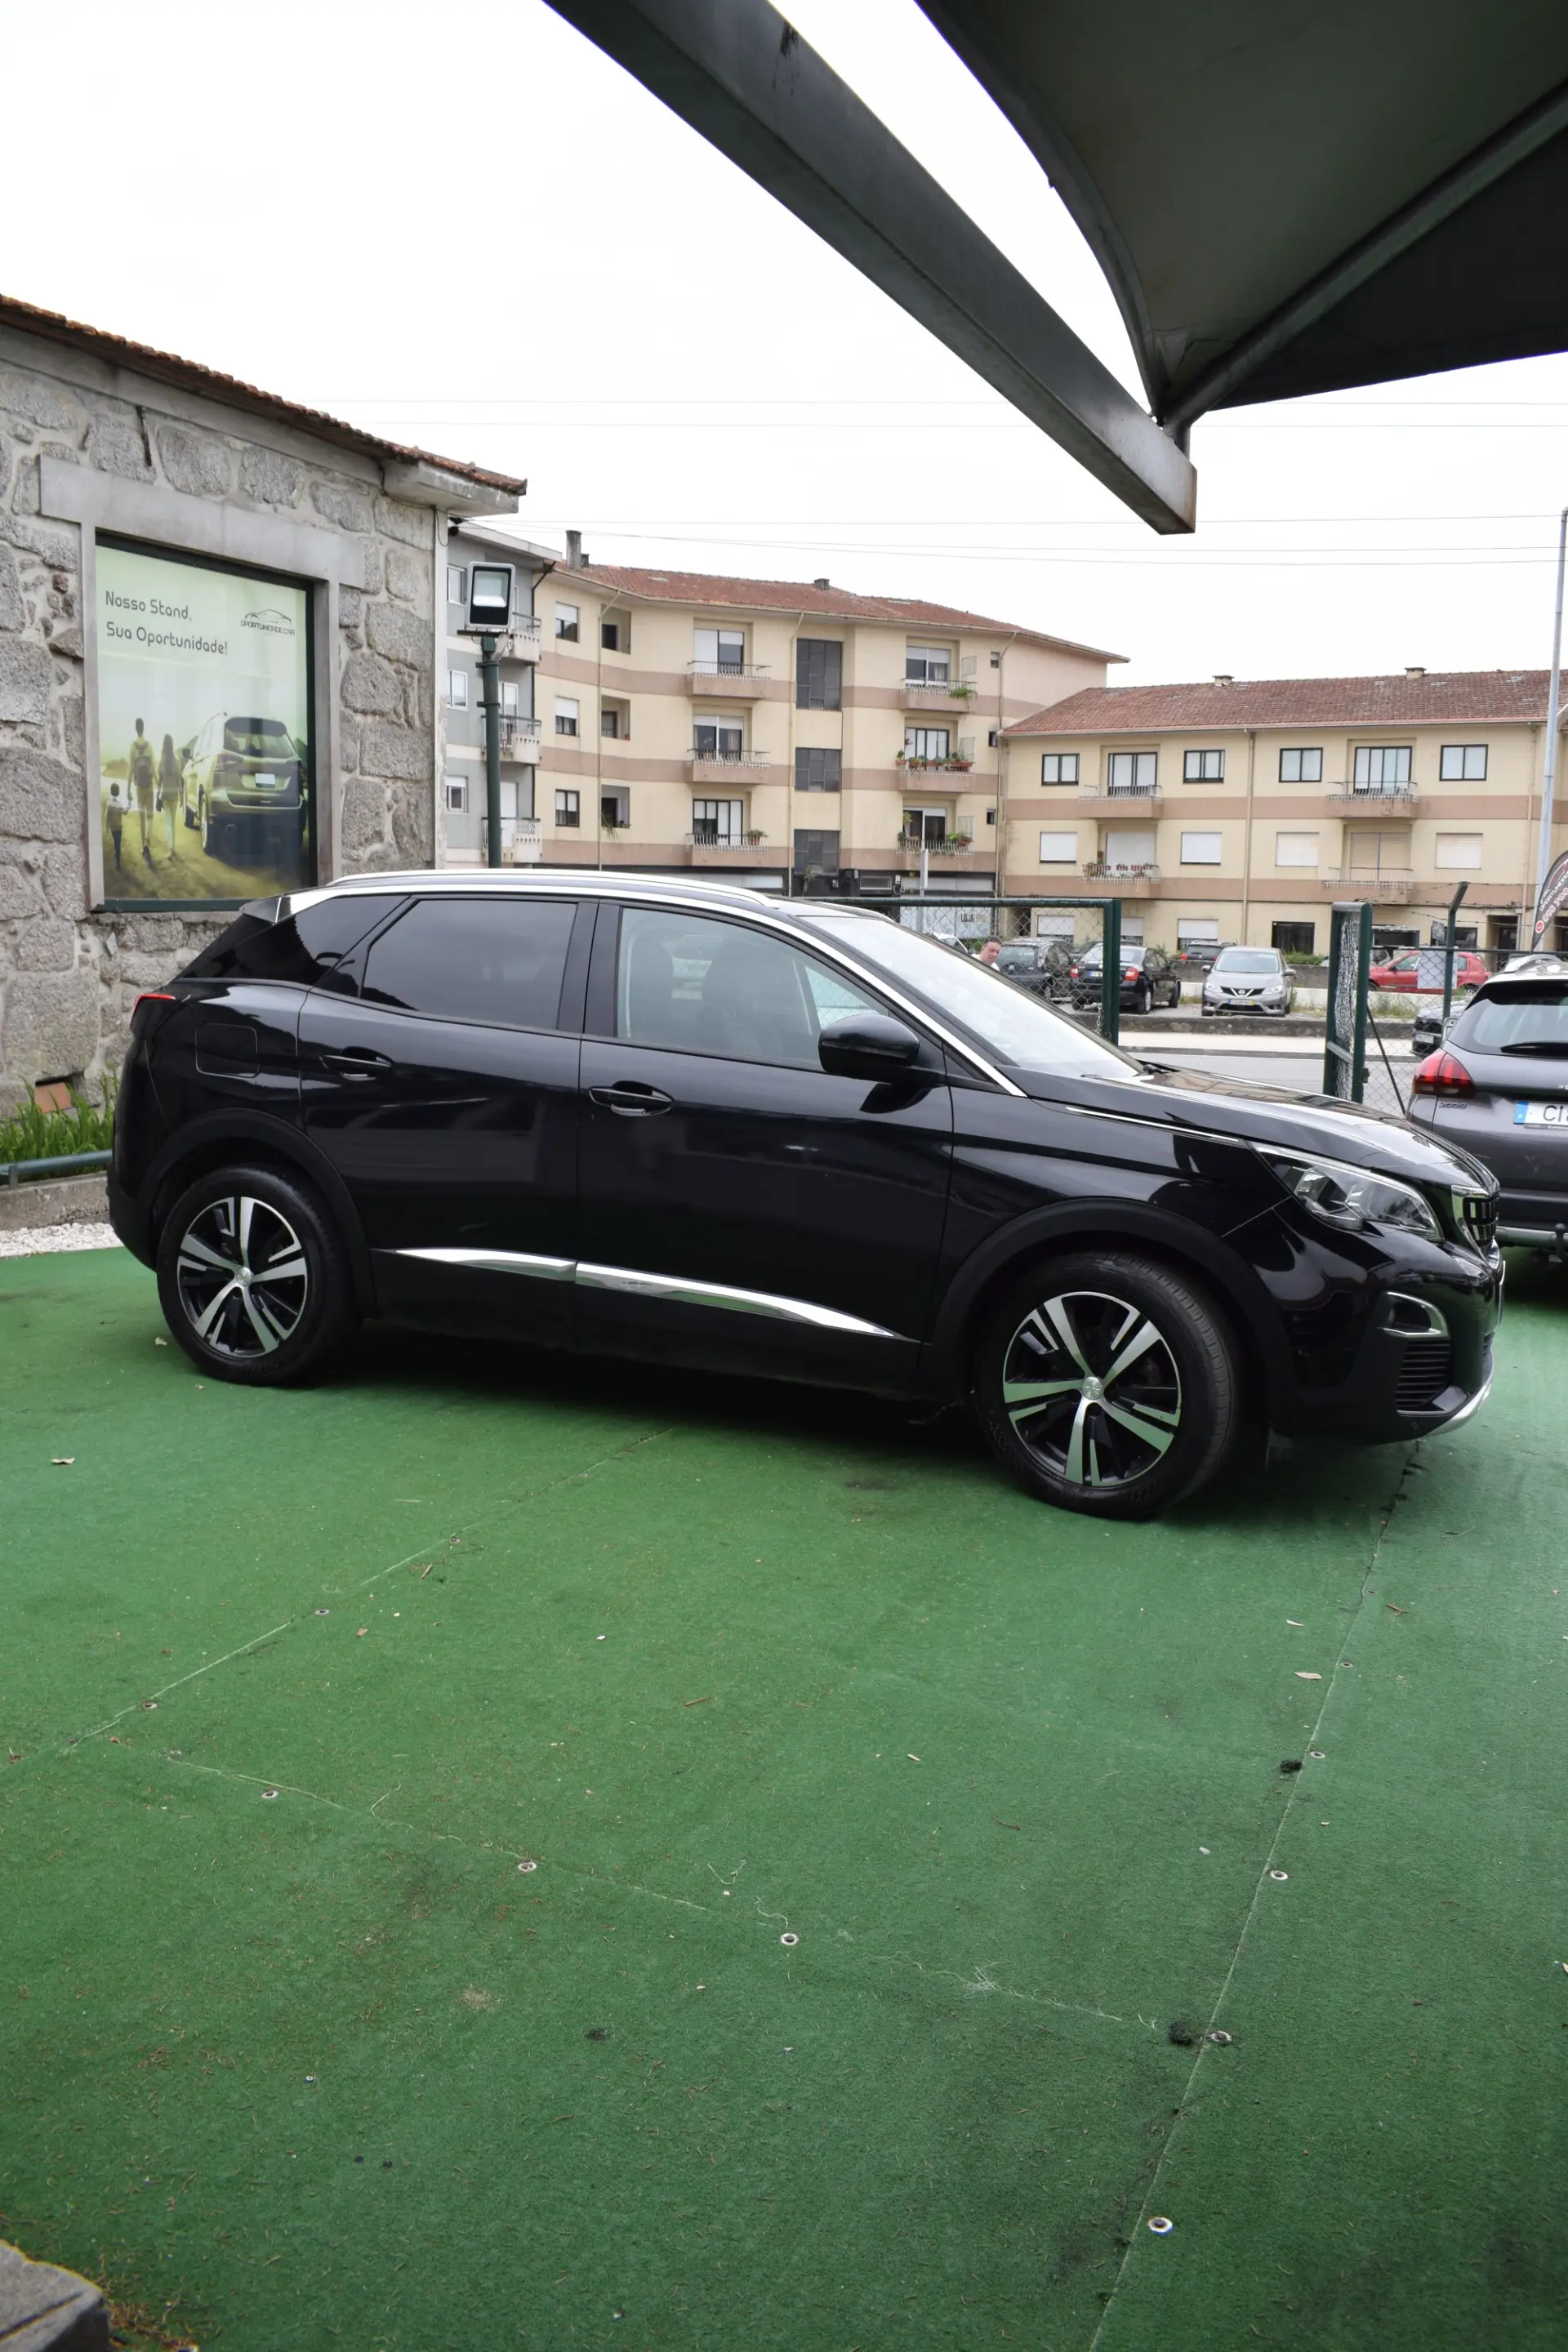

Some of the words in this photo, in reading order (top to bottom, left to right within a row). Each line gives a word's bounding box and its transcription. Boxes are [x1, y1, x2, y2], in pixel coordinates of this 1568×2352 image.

[105, 590, 146, 612] Nosso
[149, 599, 193, 622] Stand,
[106, 621, 132, 639] Sua
[136, 626, 229, 655] Oportunidade!
